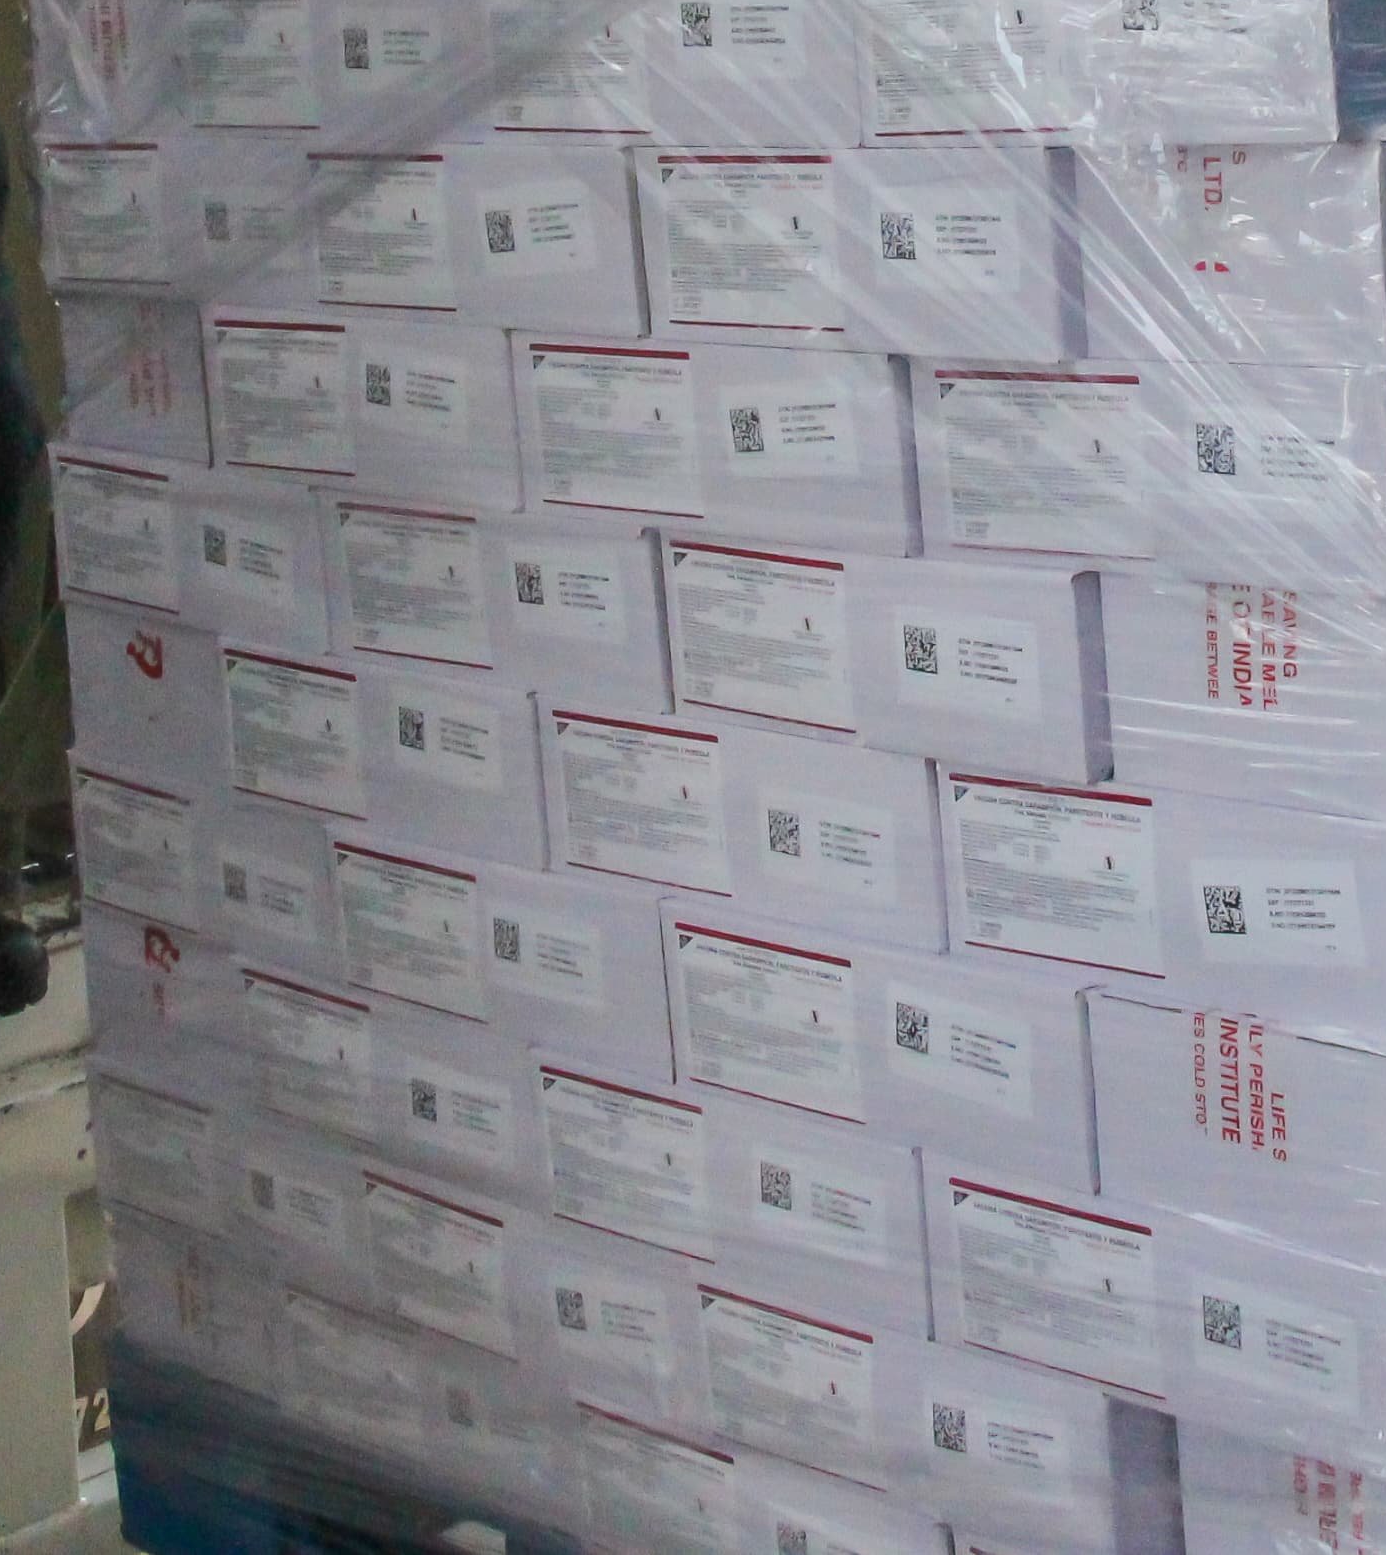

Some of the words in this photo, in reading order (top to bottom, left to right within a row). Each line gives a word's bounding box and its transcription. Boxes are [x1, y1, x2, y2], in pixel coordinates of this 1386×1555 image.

[1232, 642, 1253, 707] INDIA
[1194, 1043, 1208, 1088] COLD
[1219, 1017, 1241, 1144] INSTITUTE
[1194, 1093, 1209, 1137] STO
[1248, 1063, 1266, 1151] PERISH
[1270, 1092, 1287, 1141] LIFE
[1272, 1147, 1287, 1162] S
